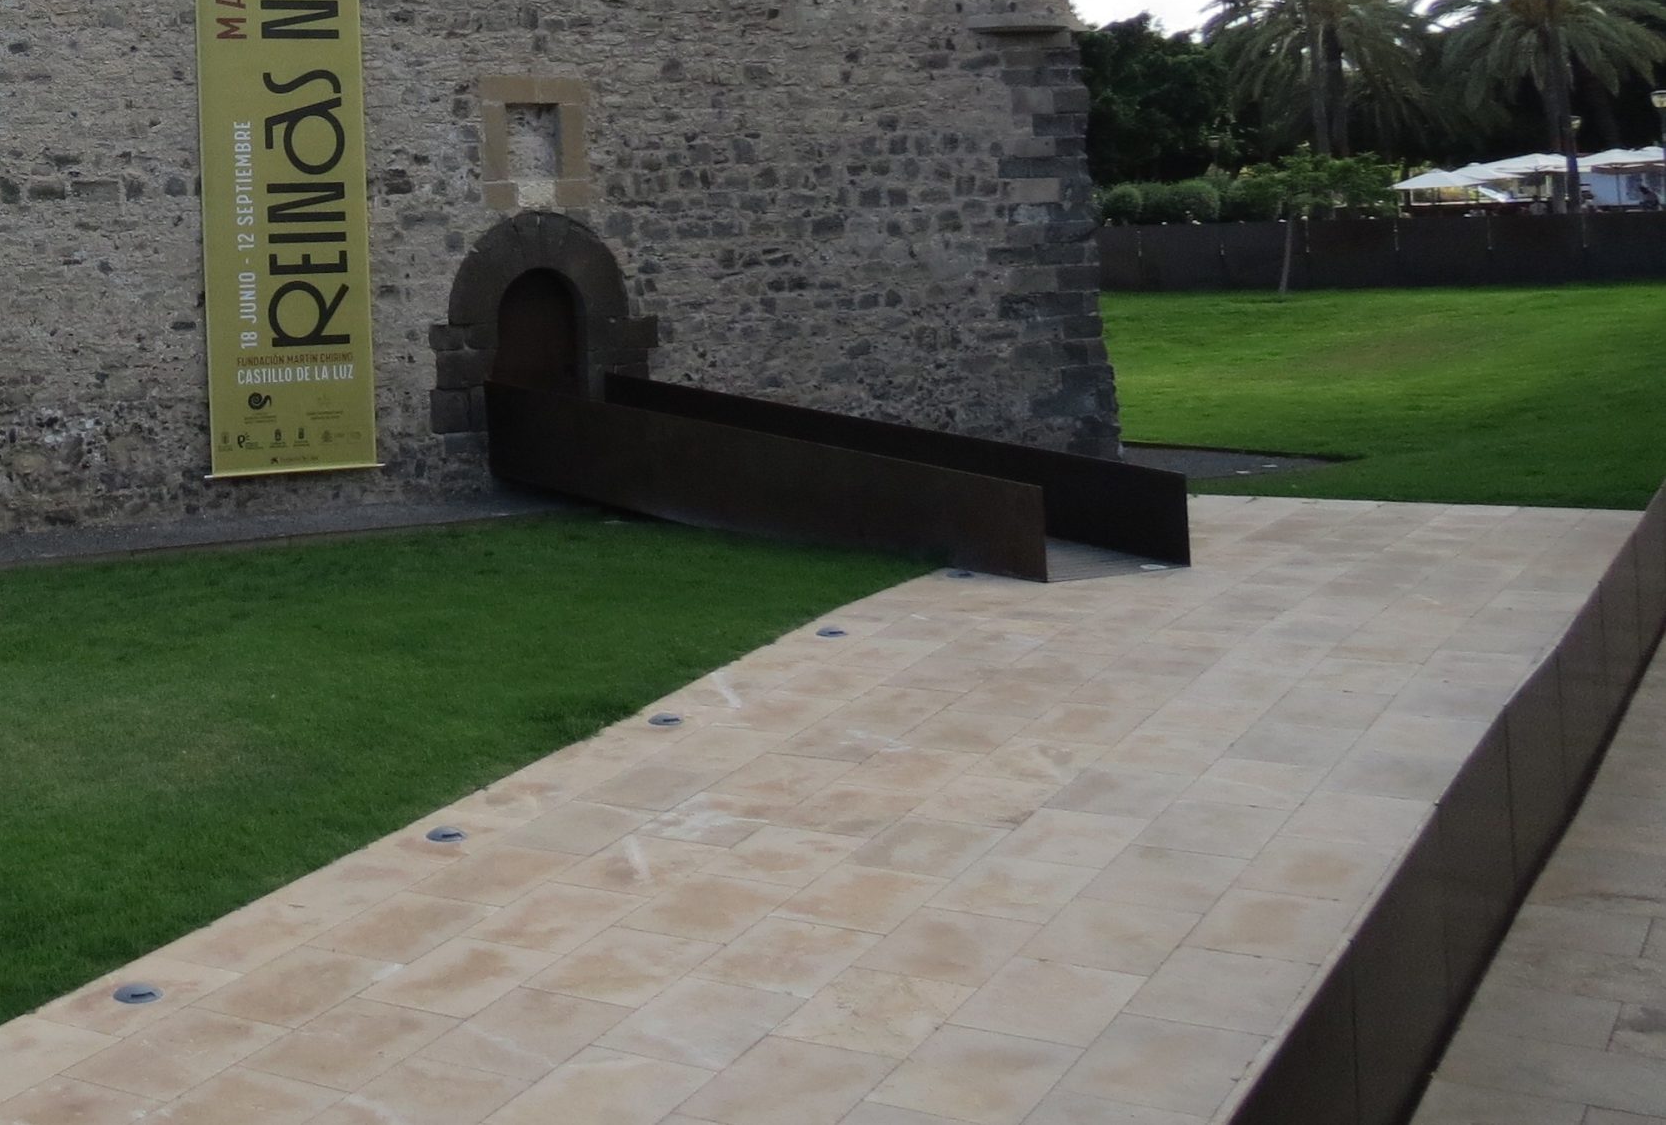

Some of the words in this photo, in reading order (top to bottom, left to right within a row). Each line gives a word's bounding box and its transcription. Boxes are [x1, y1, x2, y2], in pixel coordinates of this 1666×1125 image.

[234, 121, 254, 225] SEPTIEMBRE
[237, 233, 255, 251] 12
[238, 272, 258, 324] JUNIO
[240, 331, 258, 350] 18
[237, 355, 285, 367] FUNDACIÓN
[320, 352, 354, 363] CHIRINO
[237, 367, 293, 385] CASTILLO
[296, 366, 311, 381] DE
[315, 366, 330, 380] LA
[333, 364, 354, 379] LUZ
